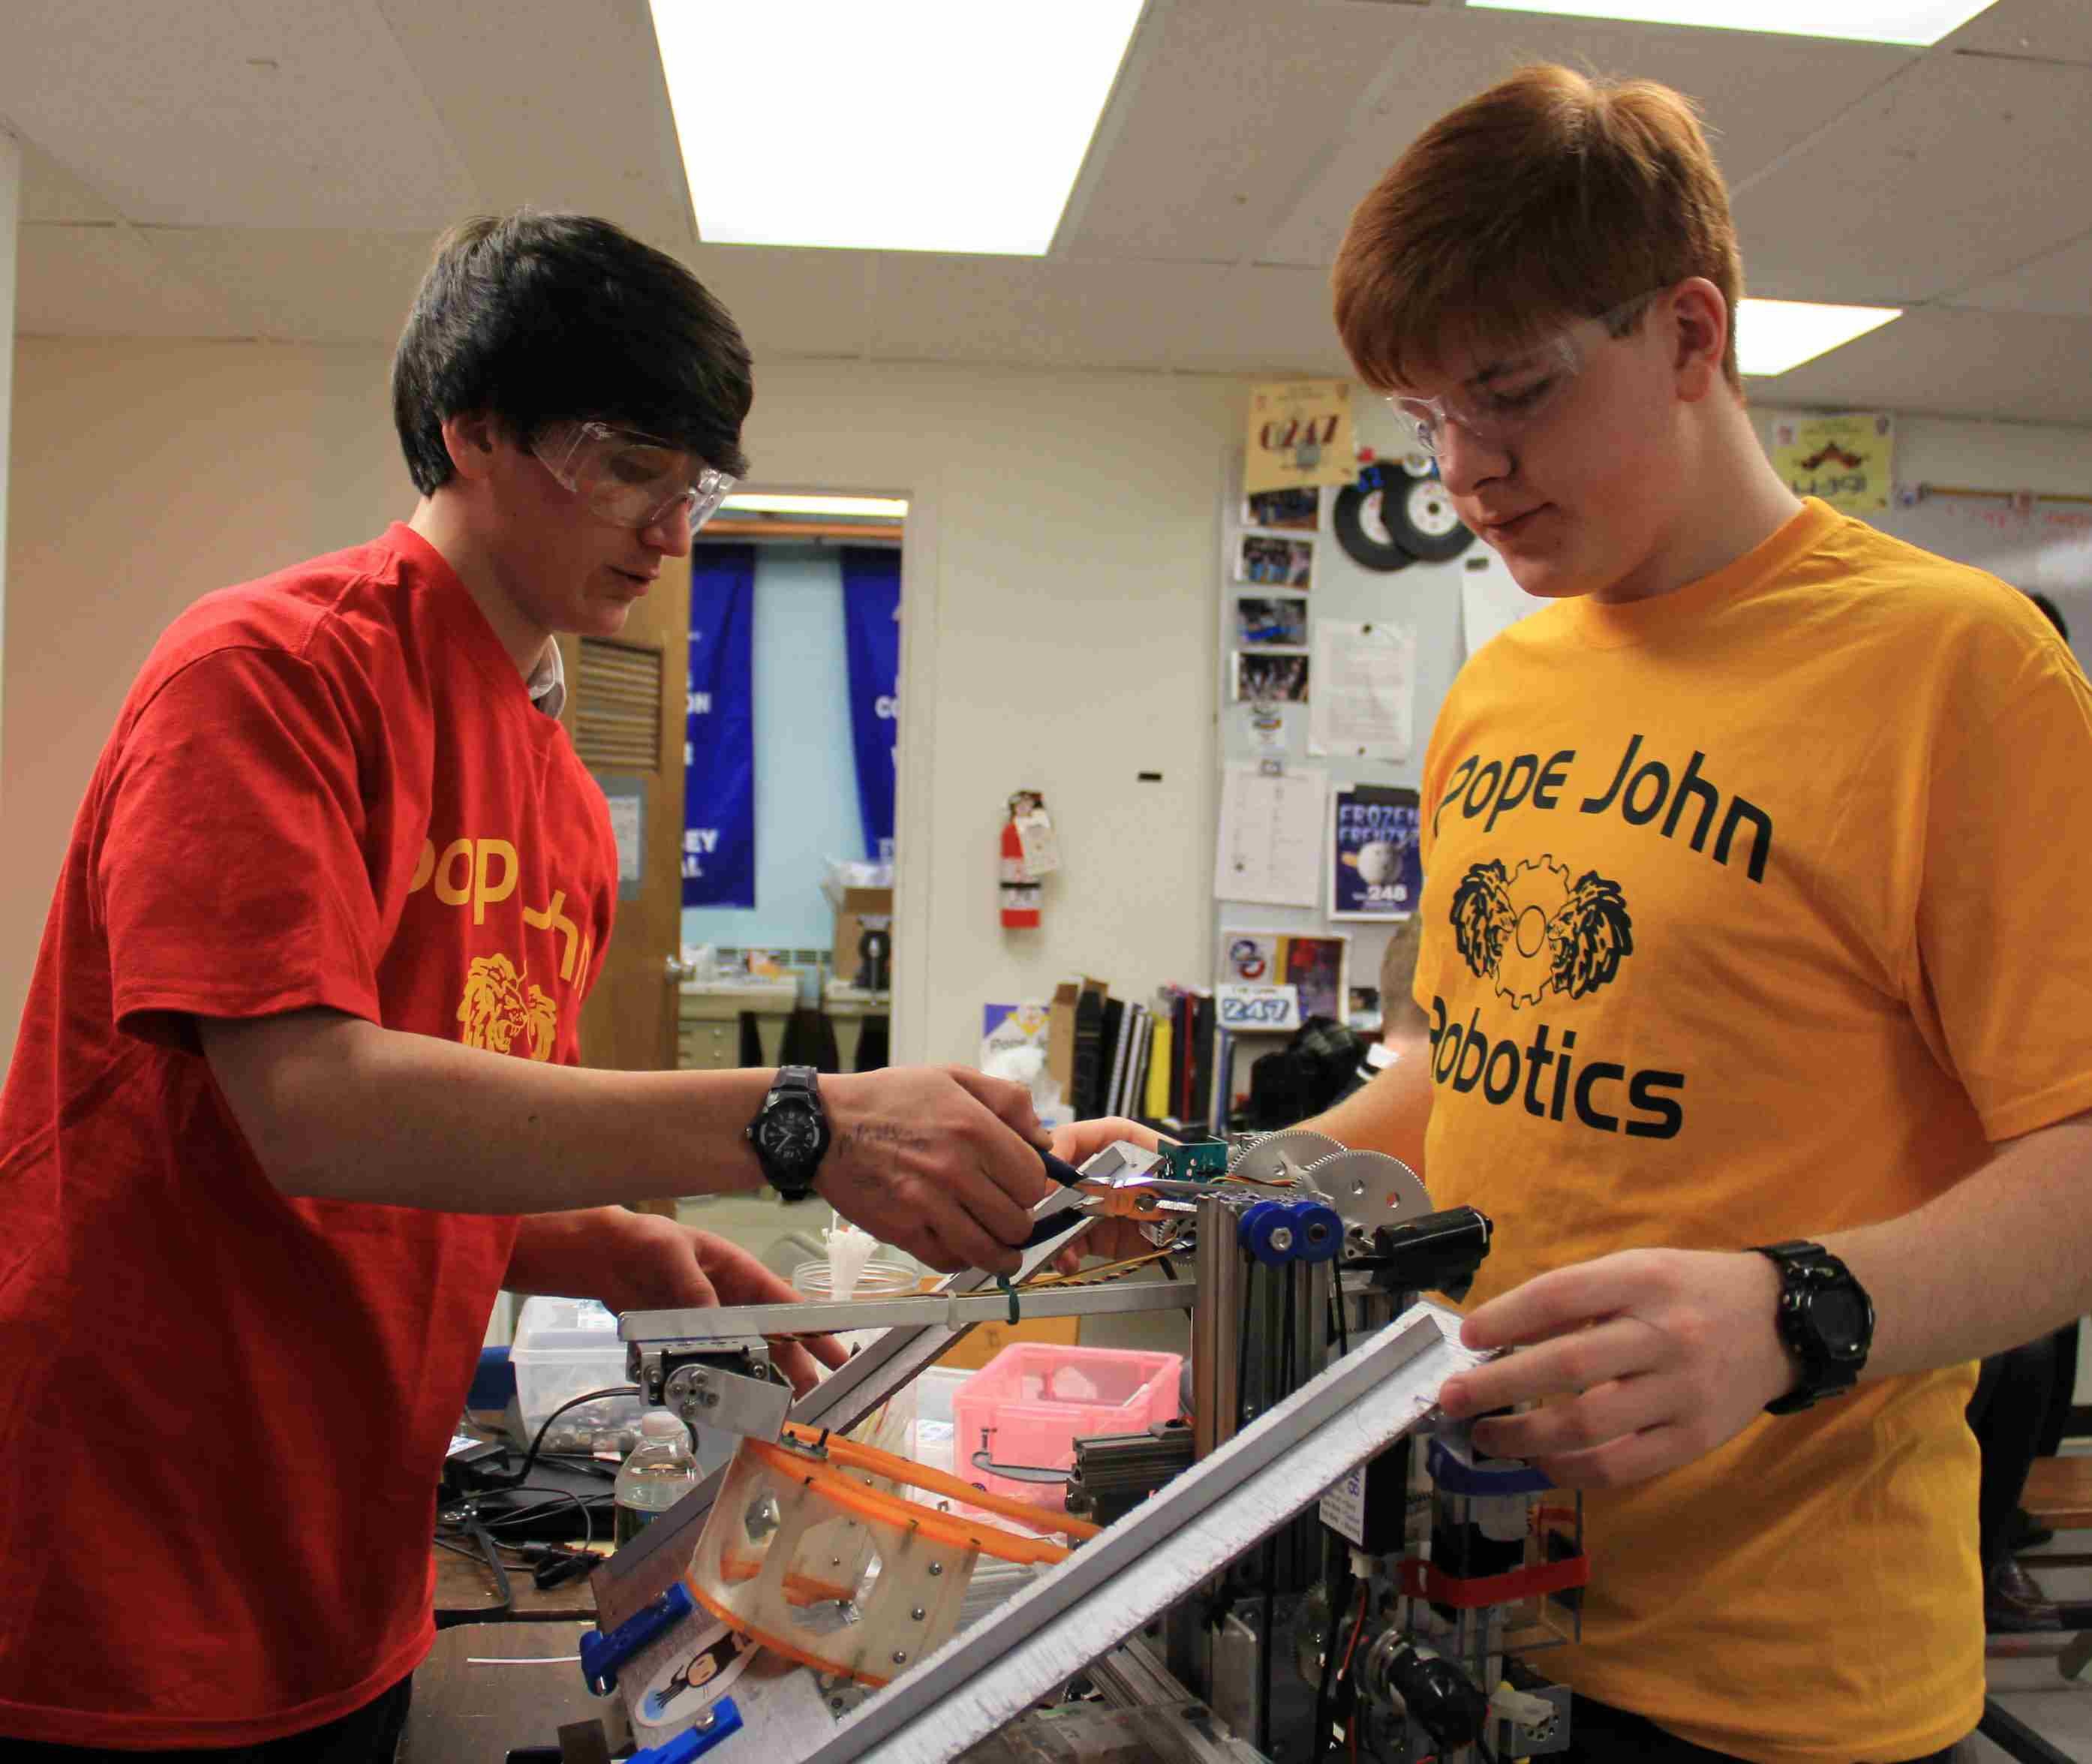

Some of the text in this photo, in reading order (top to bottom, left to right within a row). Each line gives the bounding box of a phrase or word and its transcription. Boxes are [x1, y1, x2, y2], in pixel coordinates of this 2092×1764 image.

[1579, 733, 1773, 885] John
[1222, 998, 1290, 1022] 247
[1429, 996, 1685, 1140] Robotics
